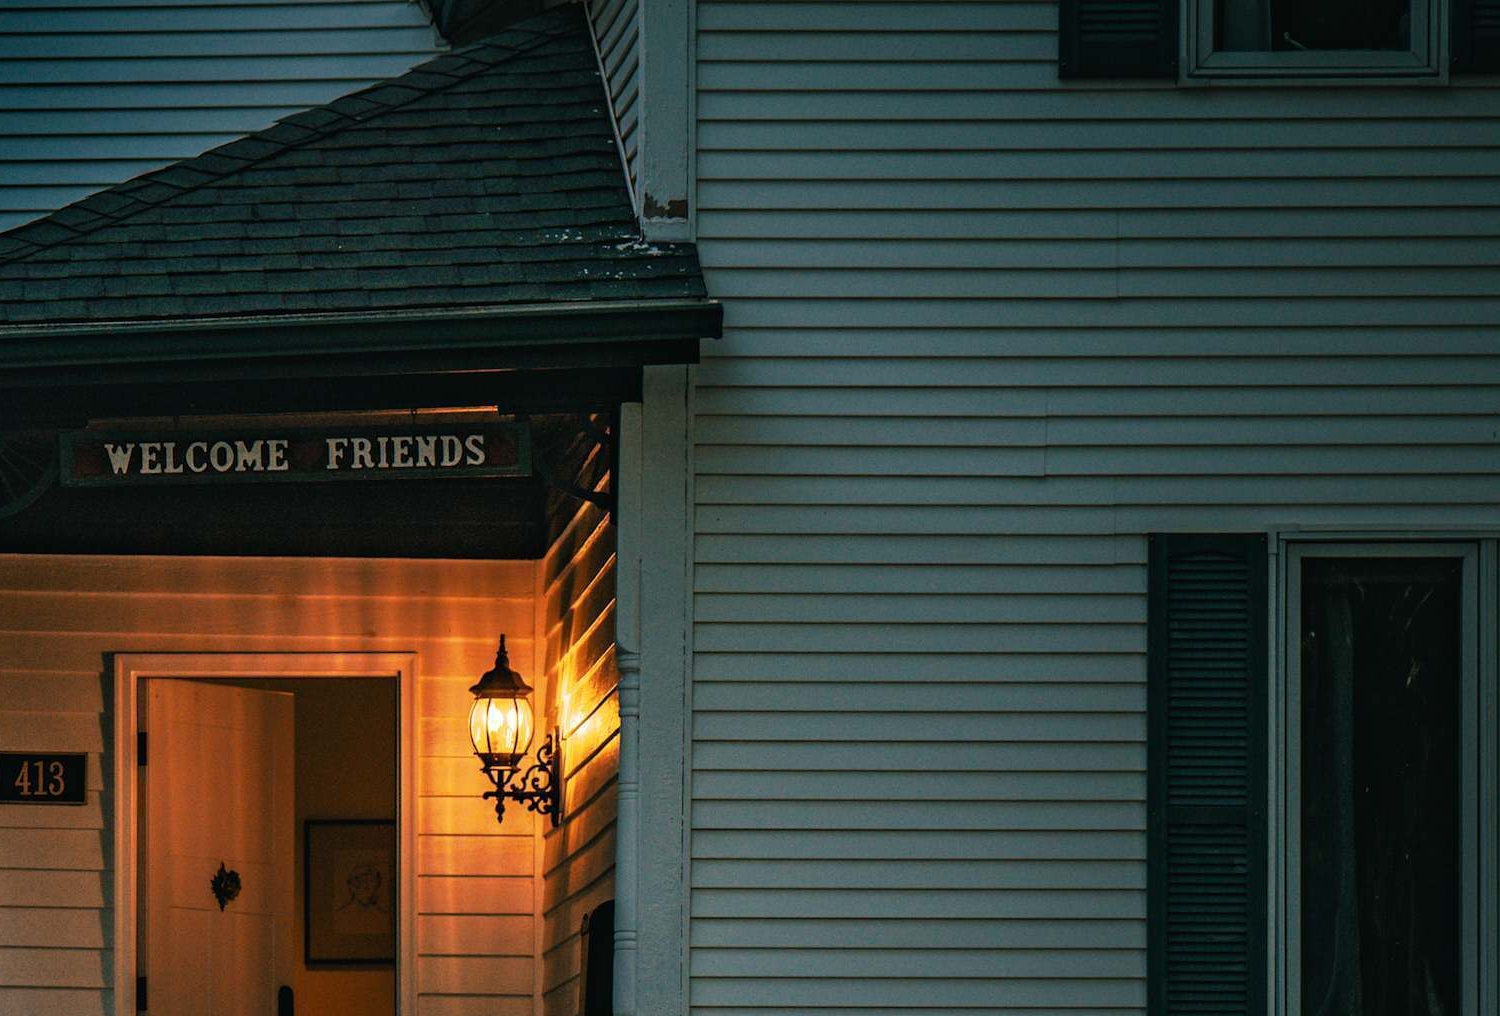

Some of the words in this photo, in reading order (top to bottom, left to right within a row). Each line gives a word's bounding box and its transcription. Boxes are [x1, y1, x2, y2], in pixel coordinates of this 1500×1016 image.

[103, 439, 289, 475] WELCOME
[326, 434, 486, 471] FRIENDS
[14, 759, 66, 796] 413
